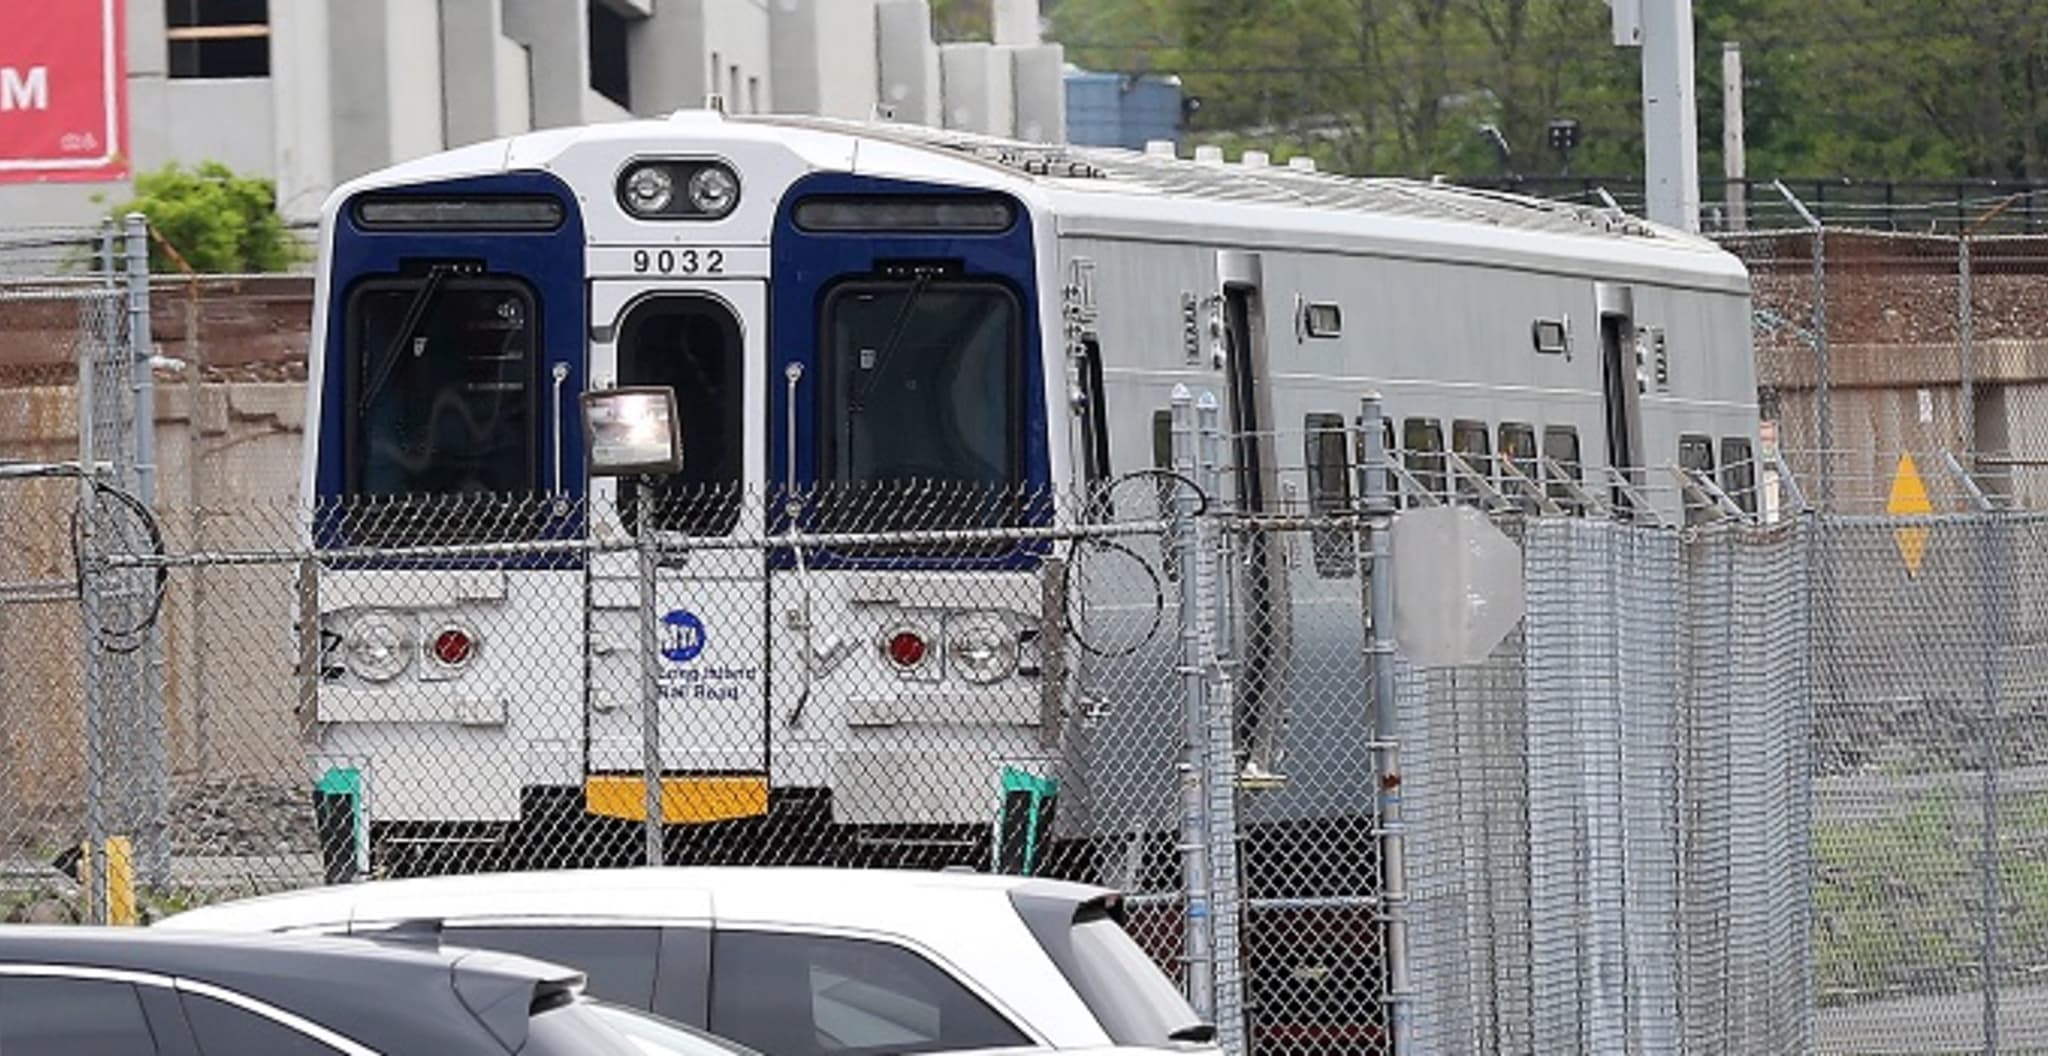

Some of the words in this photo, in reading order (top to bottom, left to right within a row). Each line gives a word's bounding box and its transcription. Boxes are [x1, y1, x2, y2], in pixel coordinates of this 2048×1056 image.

[633, 249, 723, 273] 9032
[659, 624, 700, 649] MTA
[658, 667, 699, 682] Long
[703, 666, 756, 680] Island
[694, 684, 738, 700] Road
